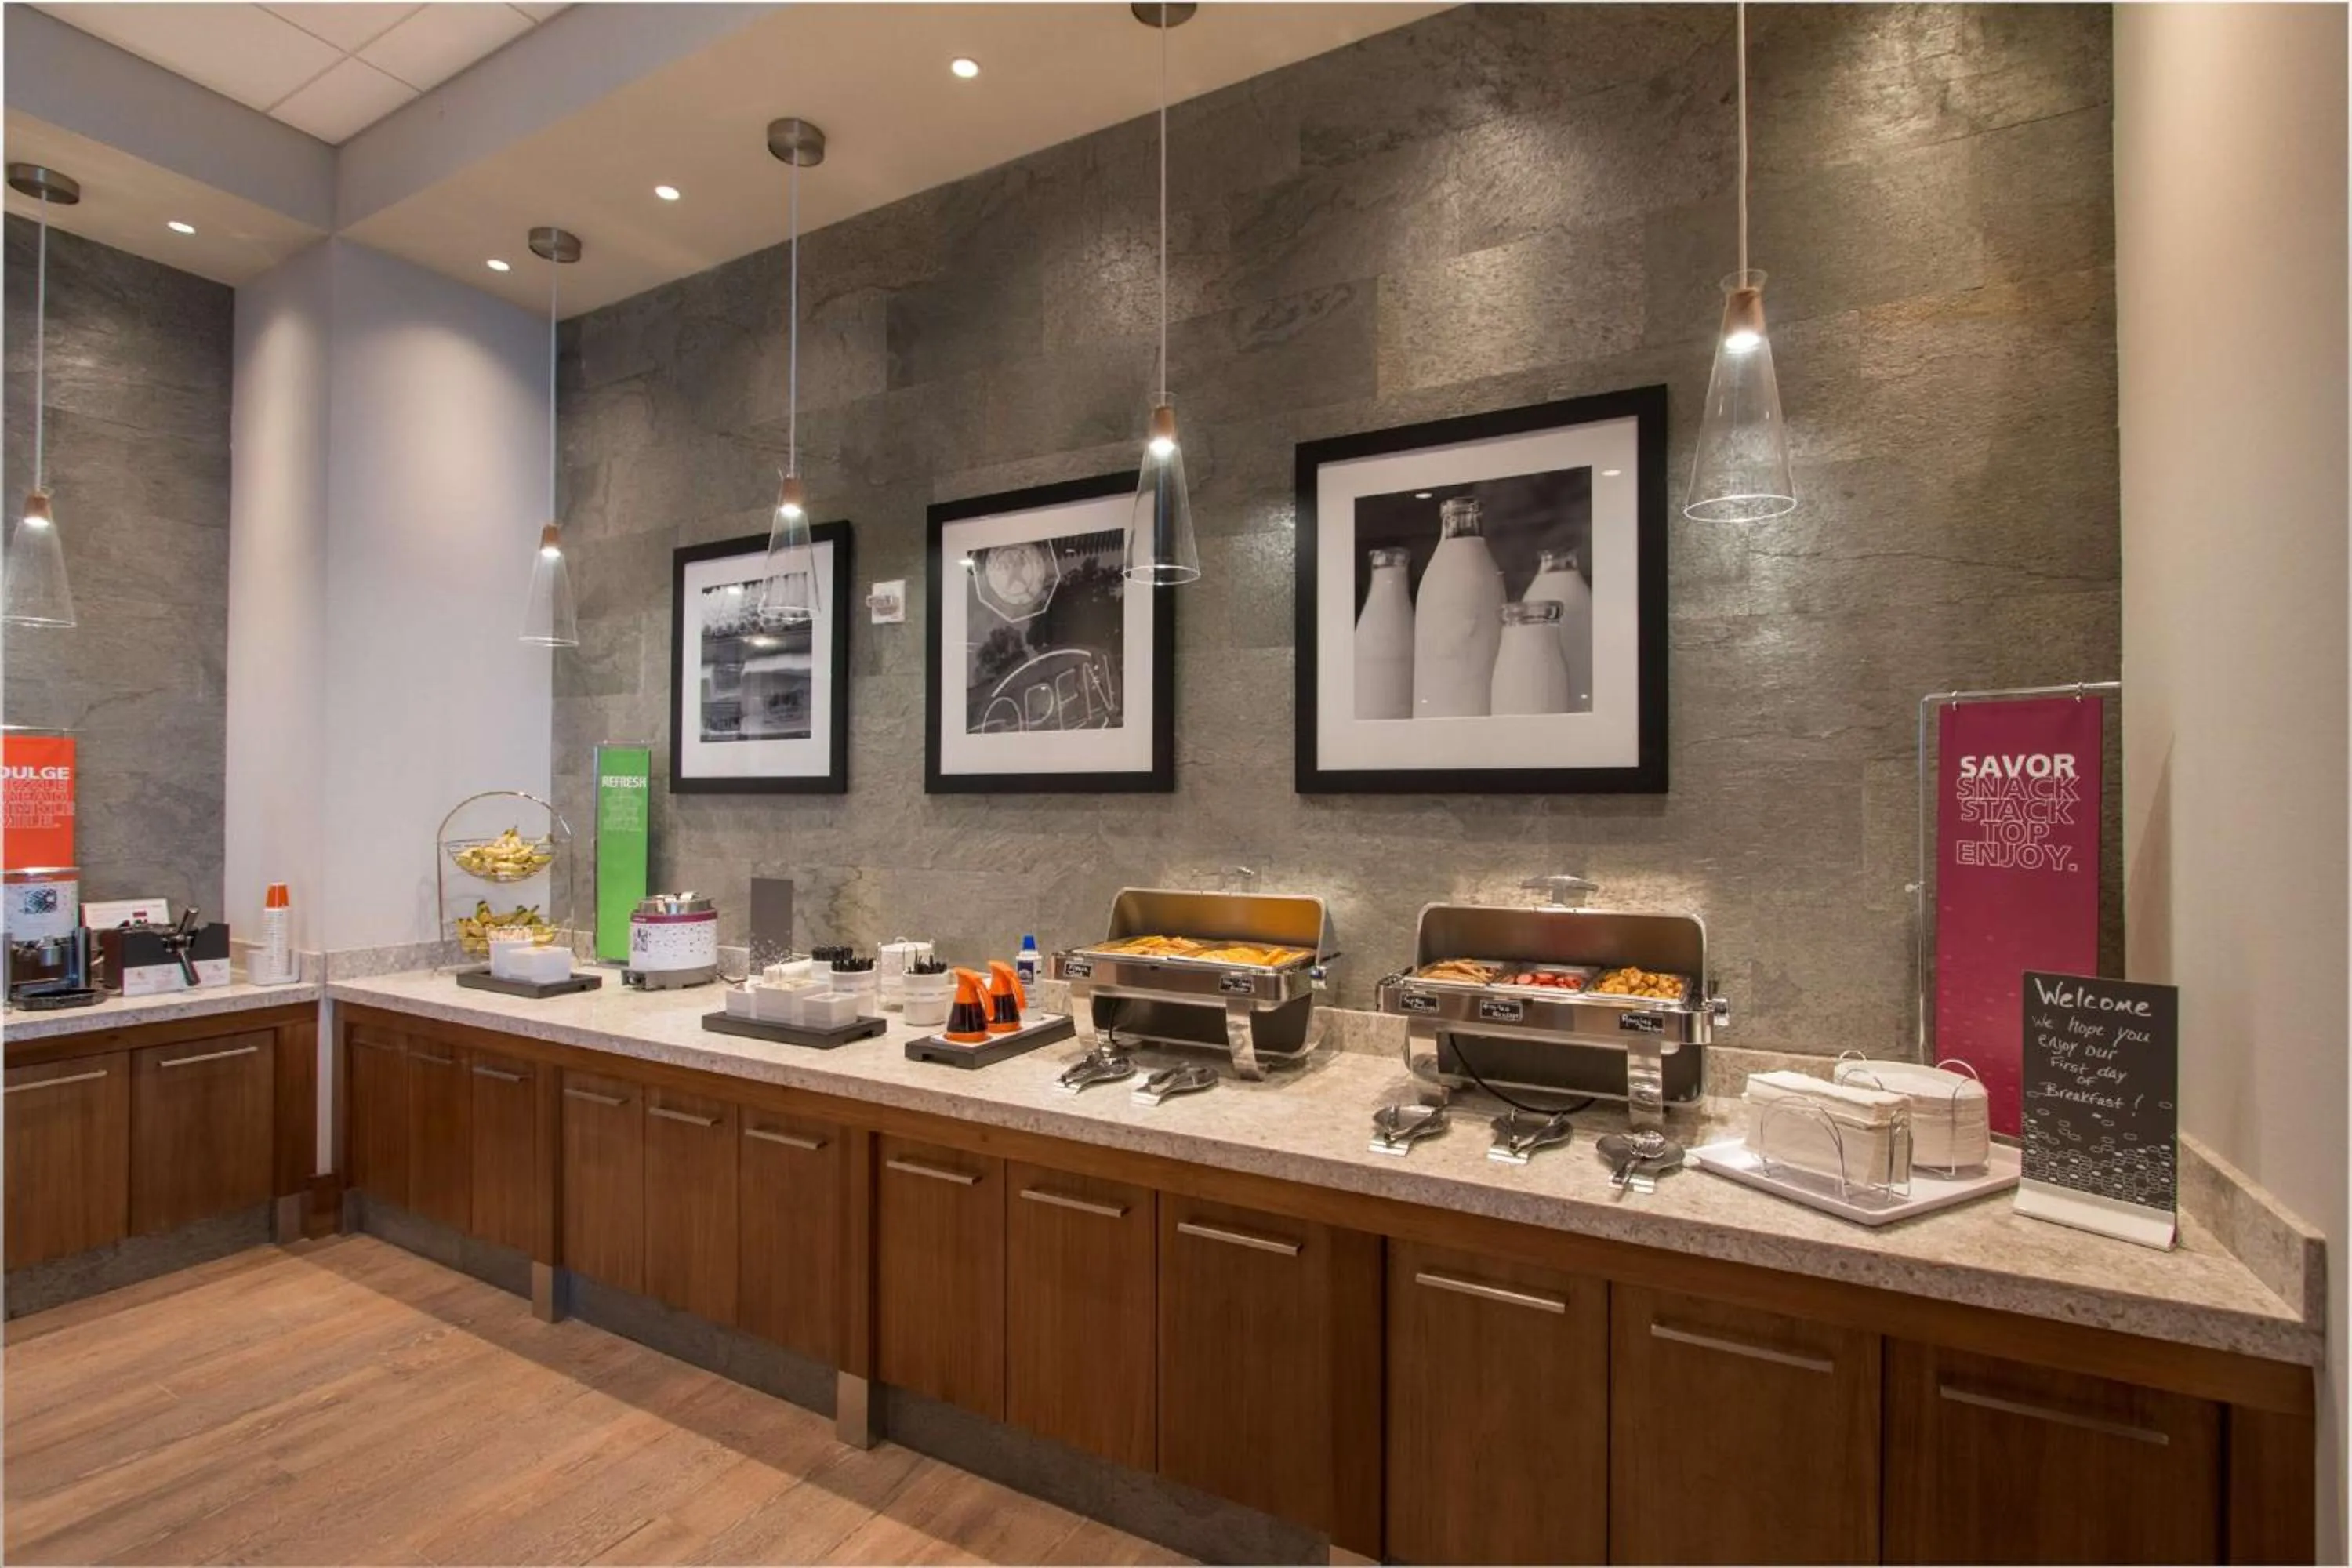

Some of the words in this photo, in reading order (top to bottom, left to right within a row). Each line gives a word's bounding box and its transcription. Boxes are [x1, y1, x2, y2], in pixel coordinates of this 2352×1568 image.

[1959, 753, 2076, 779] SAVOR
[601, 775, 647, 788] REFRESH
[1956, 775, 2081, 801] SNACK
[1960, 798, 2075, 825] STACK
[1980, 819, 2051, 846] TOP
[1956, 840, 2078, 872] ENJOY.
[2034, 977, 2152, 1017] Welcome
[2112, 1025, 2151, 1047] you
[2049, 1055, 2089, 1075] First
[2096, 1066, 2128, 1085] day
